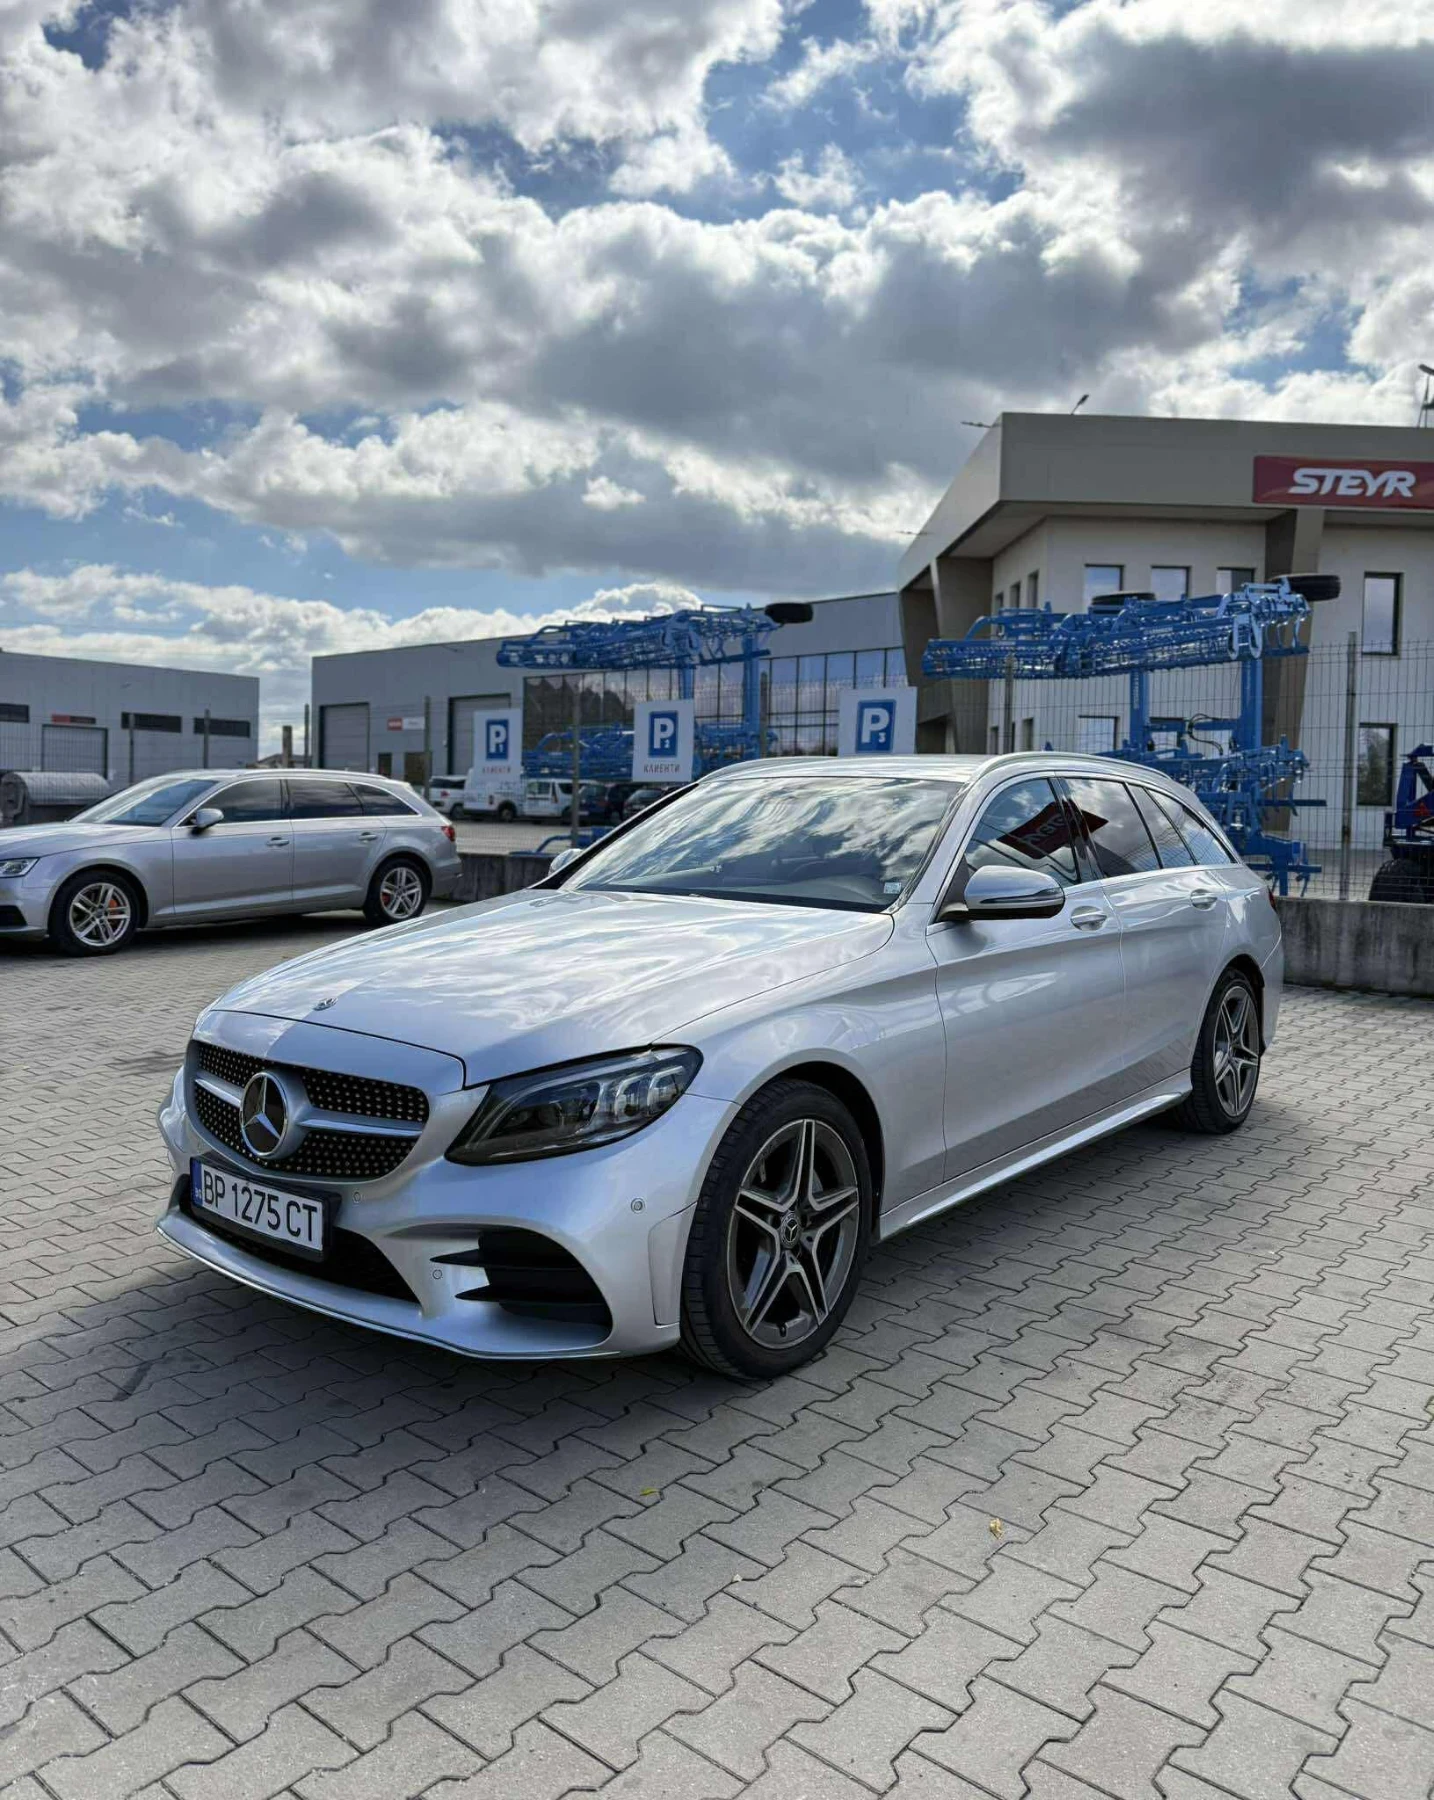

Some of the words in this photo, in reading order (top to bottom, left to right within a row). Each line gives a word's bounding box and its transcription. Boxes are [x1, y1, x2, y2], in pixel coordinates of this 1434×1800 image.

[1288, 467, 1416, 498] STEYR
[643, 763, 680, 774] КЛИЕНТИ
[231, 1182, 281, 1231] 1275
[286, 1200, 318, 1242] CT
